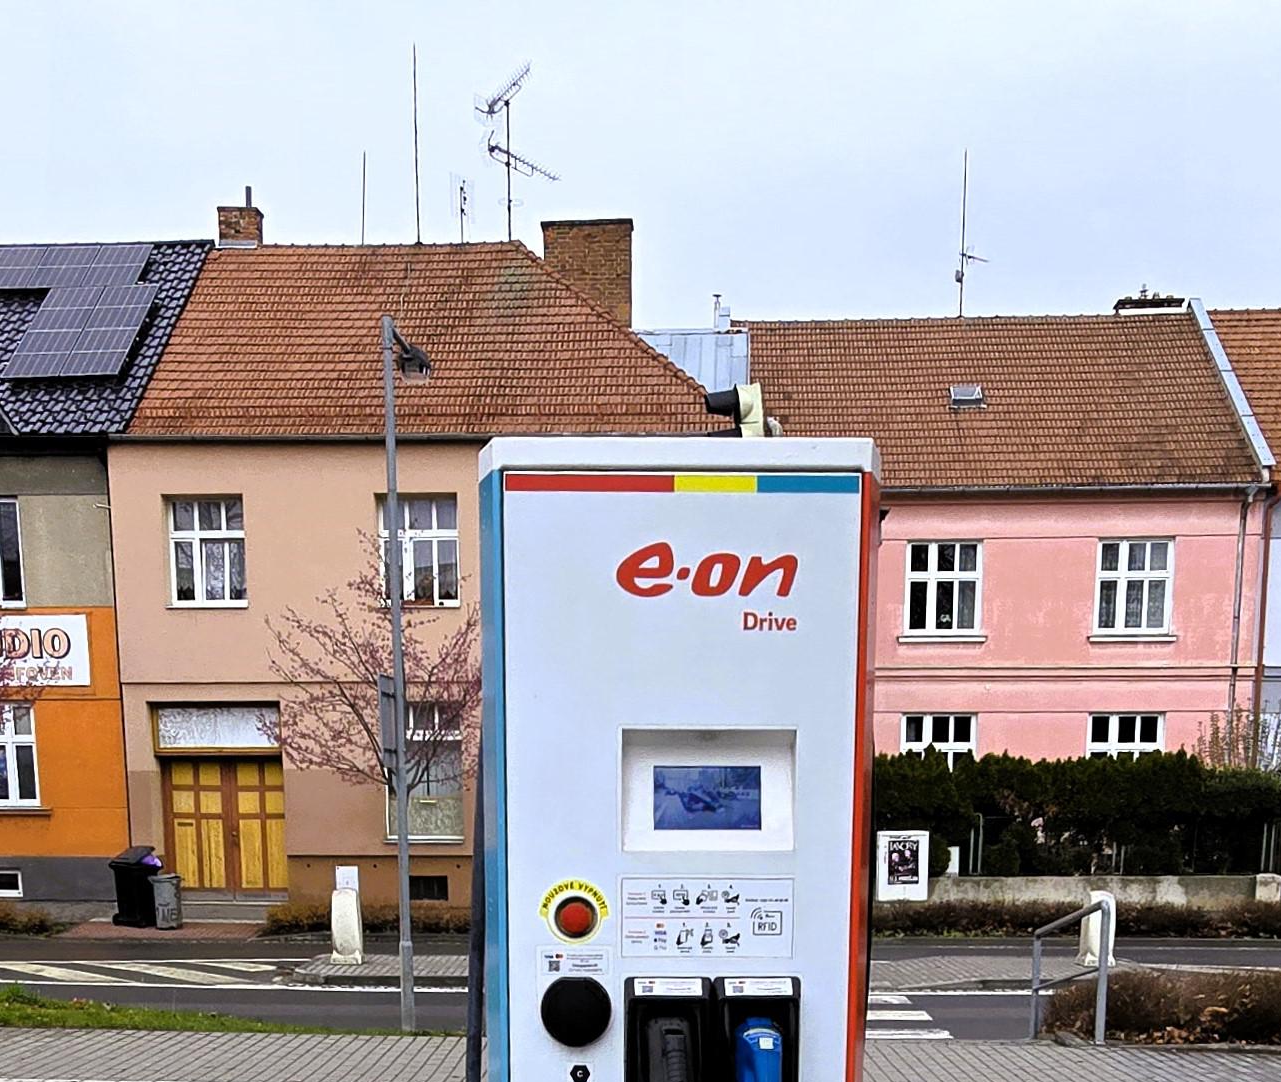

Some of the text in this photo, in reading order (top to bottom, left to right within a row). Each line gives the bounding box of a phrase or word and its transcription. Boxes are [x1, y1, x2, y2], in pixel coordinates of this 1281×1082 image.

[742, 611, 798, 632] Drive
[757, 921, 778, 932] RFID
[576, 1070, 584, 1078] C
